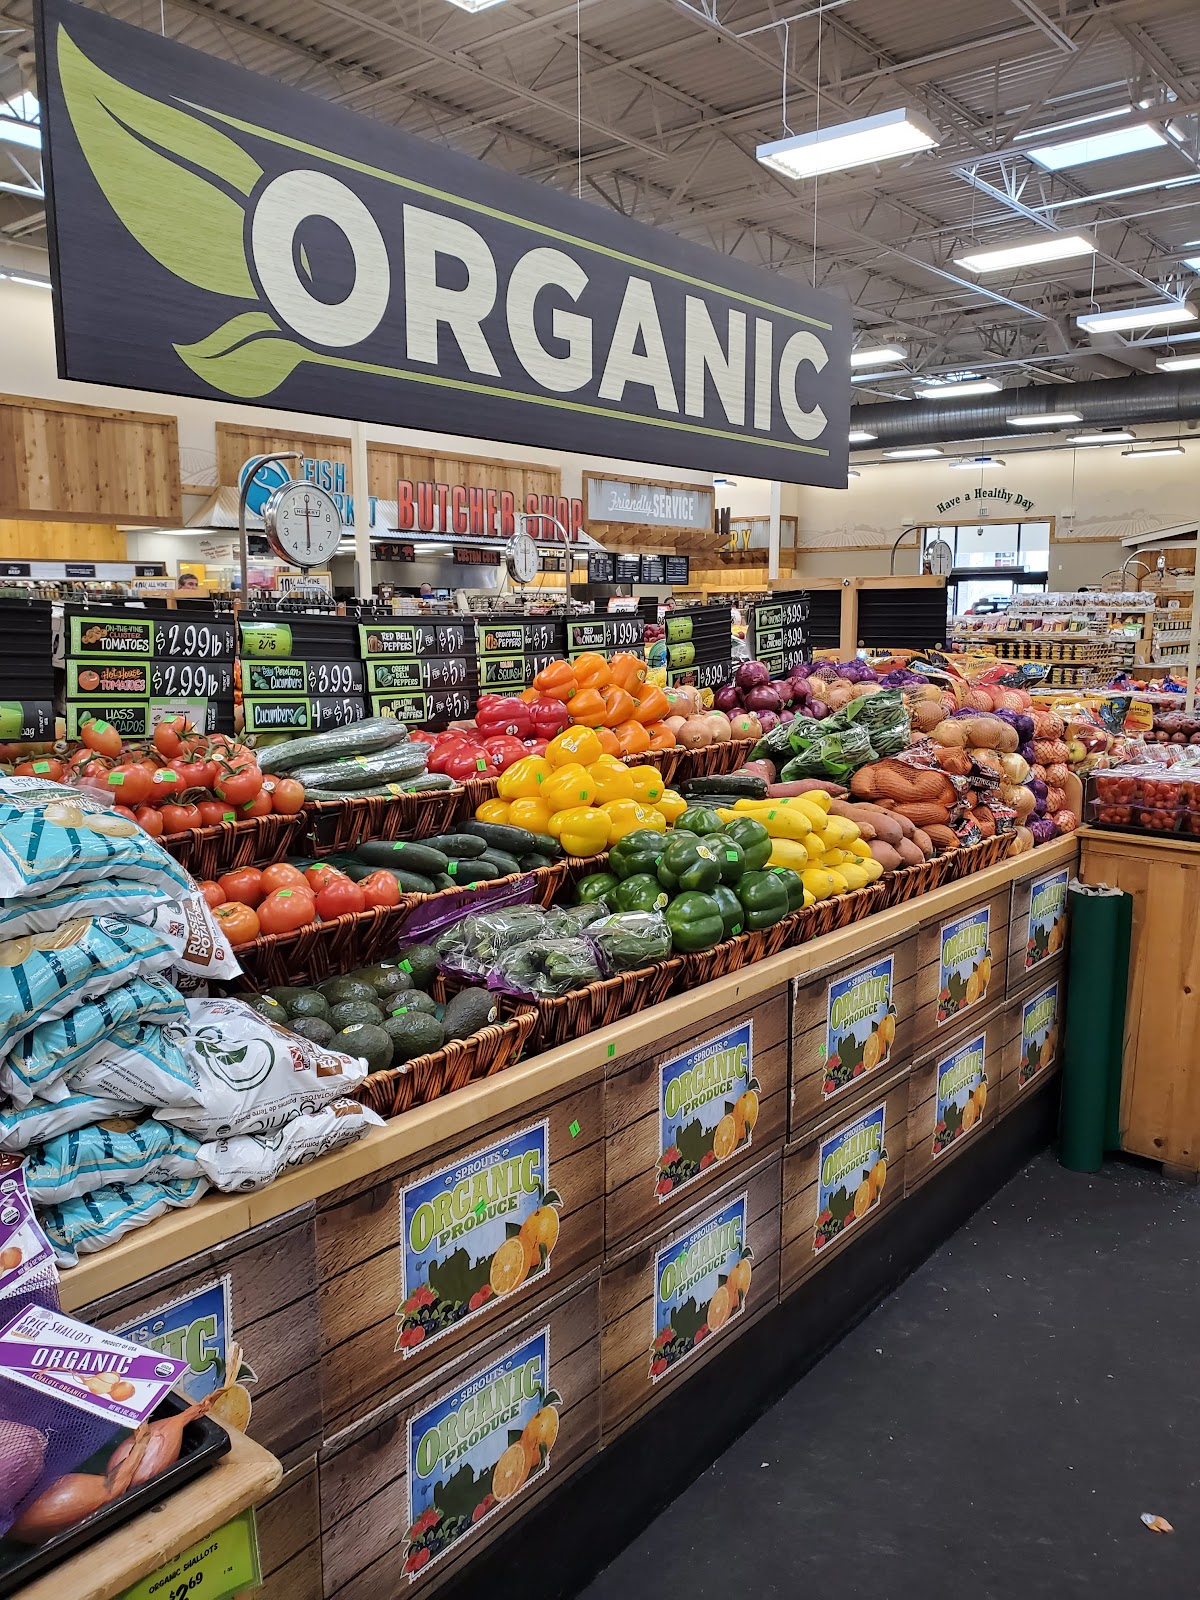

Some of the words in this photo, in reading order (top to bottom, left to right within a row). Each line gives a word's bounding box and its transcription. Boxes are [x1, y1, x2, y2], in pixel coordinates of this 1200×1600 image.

[252, 168, 829, 442] ORGANIC
[304, 458, 345, 493] FISH
[398, 479, 515, 538] BUTCHER
[526, 493, 584, 542] SHOP
[608, 491, 652, 517] Friendly
[653, 493, 694, 521] SERVICE
[936, 495, 961, 514] Have
[964, 493, 971, 501] a
[974, 487, 1013, 503] Healthy
[1014, 493, 1035, 512] Day
[283, 511, 289, 519] 2
[325, 514, 331, 522] 8
[283, 528, 289, 536] 3
[327, 531, 332, 539] 7
[292, 542, 298, 550] 4
[306, 547, 311, 555] 5
[318, 544, 324, 552] 6
[381, 632, 395, 641] RED
[395, 632, 412, 641] BELL
[416, 628, 426, 654] 2
[439, 628, 455, 653] $5
[497, 638, 522, 648] PEPPERS
[581, 634, 604, 645] ONIONS
[584, 627, 594, 636] RED
[100, 638, 149, 651] TOMATOES
[383, 642, 412, 651] PEPPERS
[101, 667, 118, 680] Hot
[119, 666, 143, 679] House
[308, 665, 352, 693] $3.99
[352, 681, 362, 692] bag
[391, 665, 409, 673] GREEN
[423, 662, 431, 687] 4
[442, 660, 458, 686] $5
[497, 667, 523, 681] SQUASH
[100, 679, 146, 691] TOMATOES
[271, 676, 302, 690] Cucumbers
[393, 679, 419, 687] PEPPERS
[105, 709, 135, 720] HASS
[255, 705, 294, 725] Cucumbers
[311, 700, 320, 727] 4
[334, 699, 353, 725] $5
[398, 710, 423, 720] PEPPERS
[427, 695, 435, 720] 2
[446, 692, 461, 717] $5
[186, 907, 201, 955] RUSSET
[831, 974, 889, 1031] ORGANIC
[843, 1004, 878, 1030] PRODUCE
[694, 1042, 723, 1064] SPROUTS
[665, 1043, 747, 1119] ORGANIC
[269, 1104, 277, 1112] de
[299, 1091, 334, 1103] POTATOES
[683, 1080, 733, 1117] PRODUCE
[251, 1107, 269, 1117] Terre
[822, 1121, 881, 1187] ORGANIC
[455, 1150, 500, 1182] SPROUTS
[834, 1152, 870, 1185] PRODUCE
[410, 1148, 540, 1254] ORGANIC
[438, 1195, 518, 1248] PRODUCE
[689, 1220, 719, 1245] SPROUTS
[660, 1215, 741, 1302] ORGANIC
[678, 1253, 727, 1297] PRODUCE
[15, 1324, 41, 1339] WORLD
[20, 1315, 48, 1331] SPICE
[48, 1321, 94, 1344] SHALLOTS
[101, 1339, 122, 1349] PRODUCT
[31, 1348, 133, 1375] ORGANIC
[31, 1372, 58, 1389] ECHALOTE
[59, 1384, 88, 1399] ORGANICO
[460, 1364, 504, 1402] SPROUTS
[416, 1354, 541, 1479] ORGANIC
[444, 1402, 520, 1469] PRODUCE
[148, 1568, 182, 1594] ORGANIC
[183, 1542, 218, 1571] SHALLOTS
